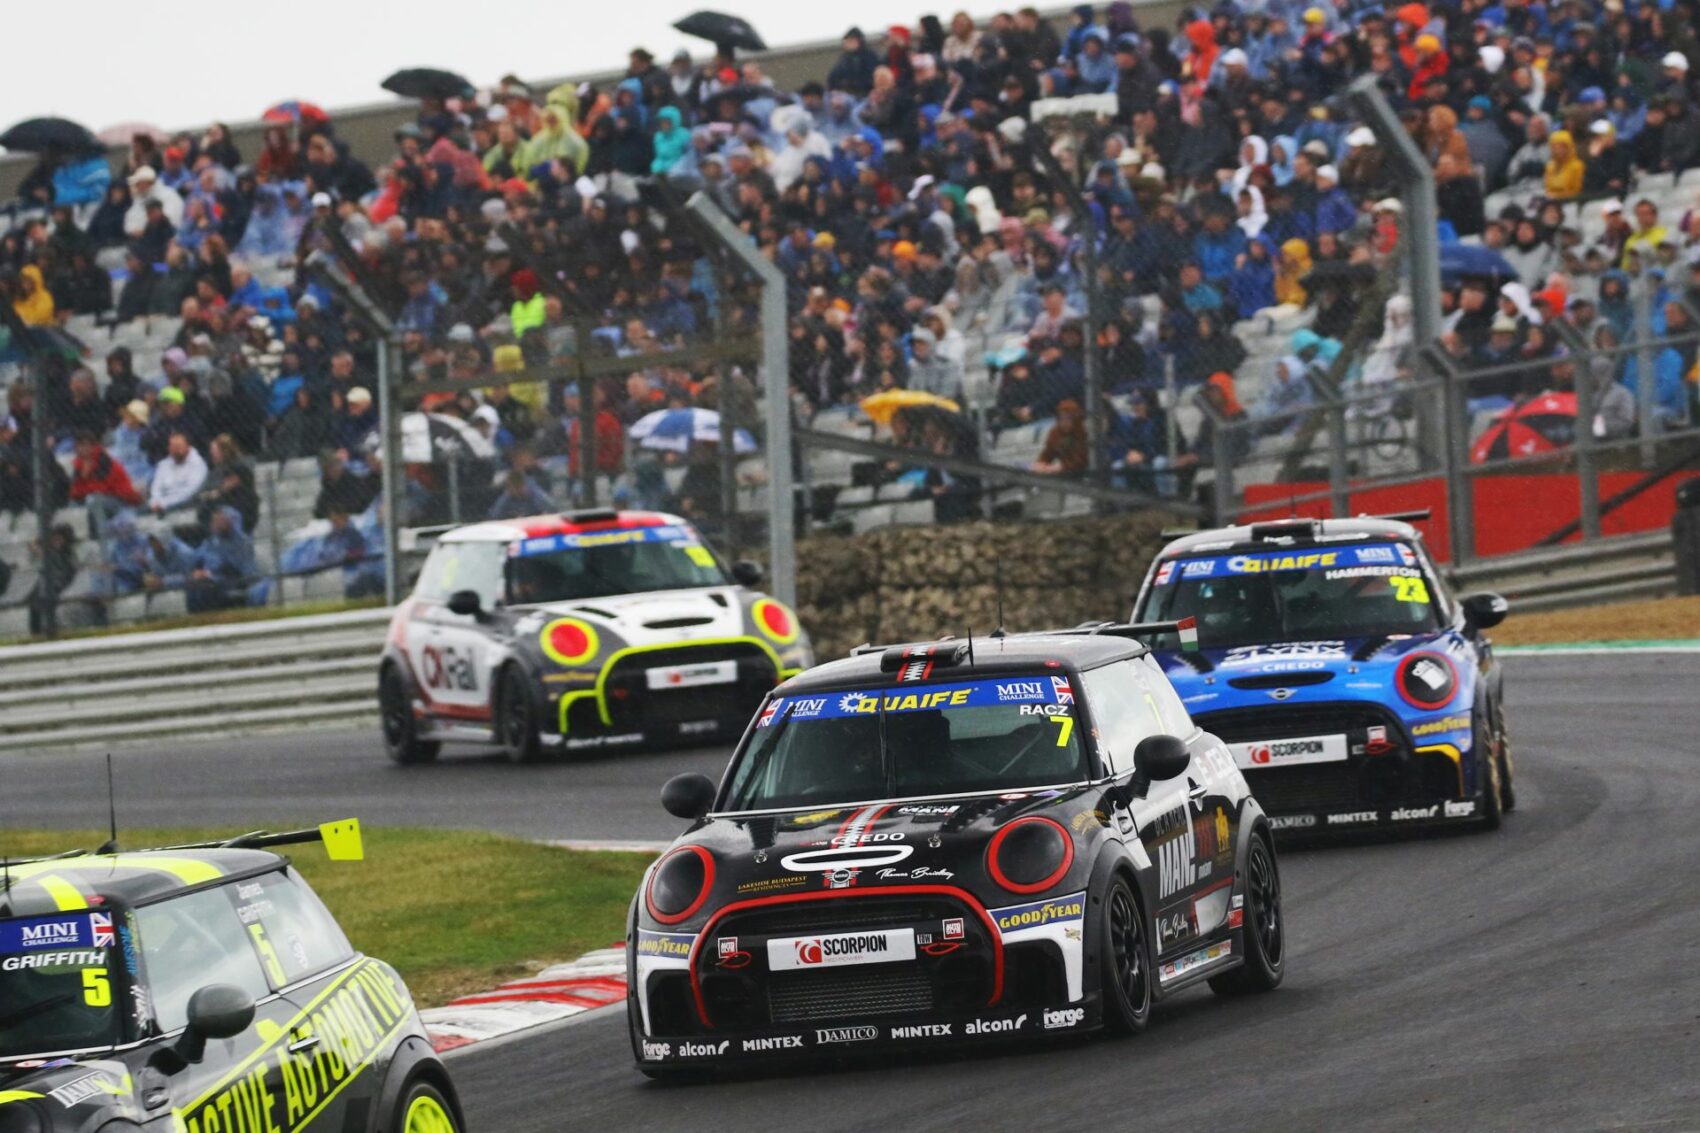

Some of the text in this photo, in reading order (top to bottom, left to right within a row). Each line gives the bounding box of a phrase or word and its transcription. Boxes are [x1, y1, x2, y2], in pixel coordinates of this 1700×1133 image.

[1243, 552, 1337, 572] QUAIFE
[1325, 566, 1421, 580] HAMMERTON
[1389, 576, 1430, 604] 23
[1262, 661, 1325, 673] CREDO
[996, 682, 1044, 696] MINI
[999, 693, 1045, 701] CHALLENGE
[857, 689, 972, 714] QUAIFE
[1020, 704, 1069, 716] RACZ
[1050, 716, 1073, 747] 7
[1270, 740, 1324, 757] SCORPION
[1327, 811, 1378, 824] MINTEX
[1390, 807, 1428, 820] alcon
[831, 832, 905, 846] CREDO
[771, 875, 807, 885] BUDAPEST
[20, 922, 79, 941] MINI
[22, 936, 79, 947] CHALLENGE
[823, 934, 887, 956] SCORPION
[2, 951, 106, 971] GRIFFITH
[248, 923, 287, 987] 5
[82, 968, 111, 1007] 5
[965, 1018, 1013, 1034] alcon
[1044, 1007, 1084, 1029] forge
[891, 1024, 952, 1040] MINTEX
[188, 961, 408, 1133] TIVE AUTOMOTIVE
[643, 1040, 670, 1060] forge
[679, 1042, 717, 1057] alcon
[743, 1036, 803, 1052] MINTEX
